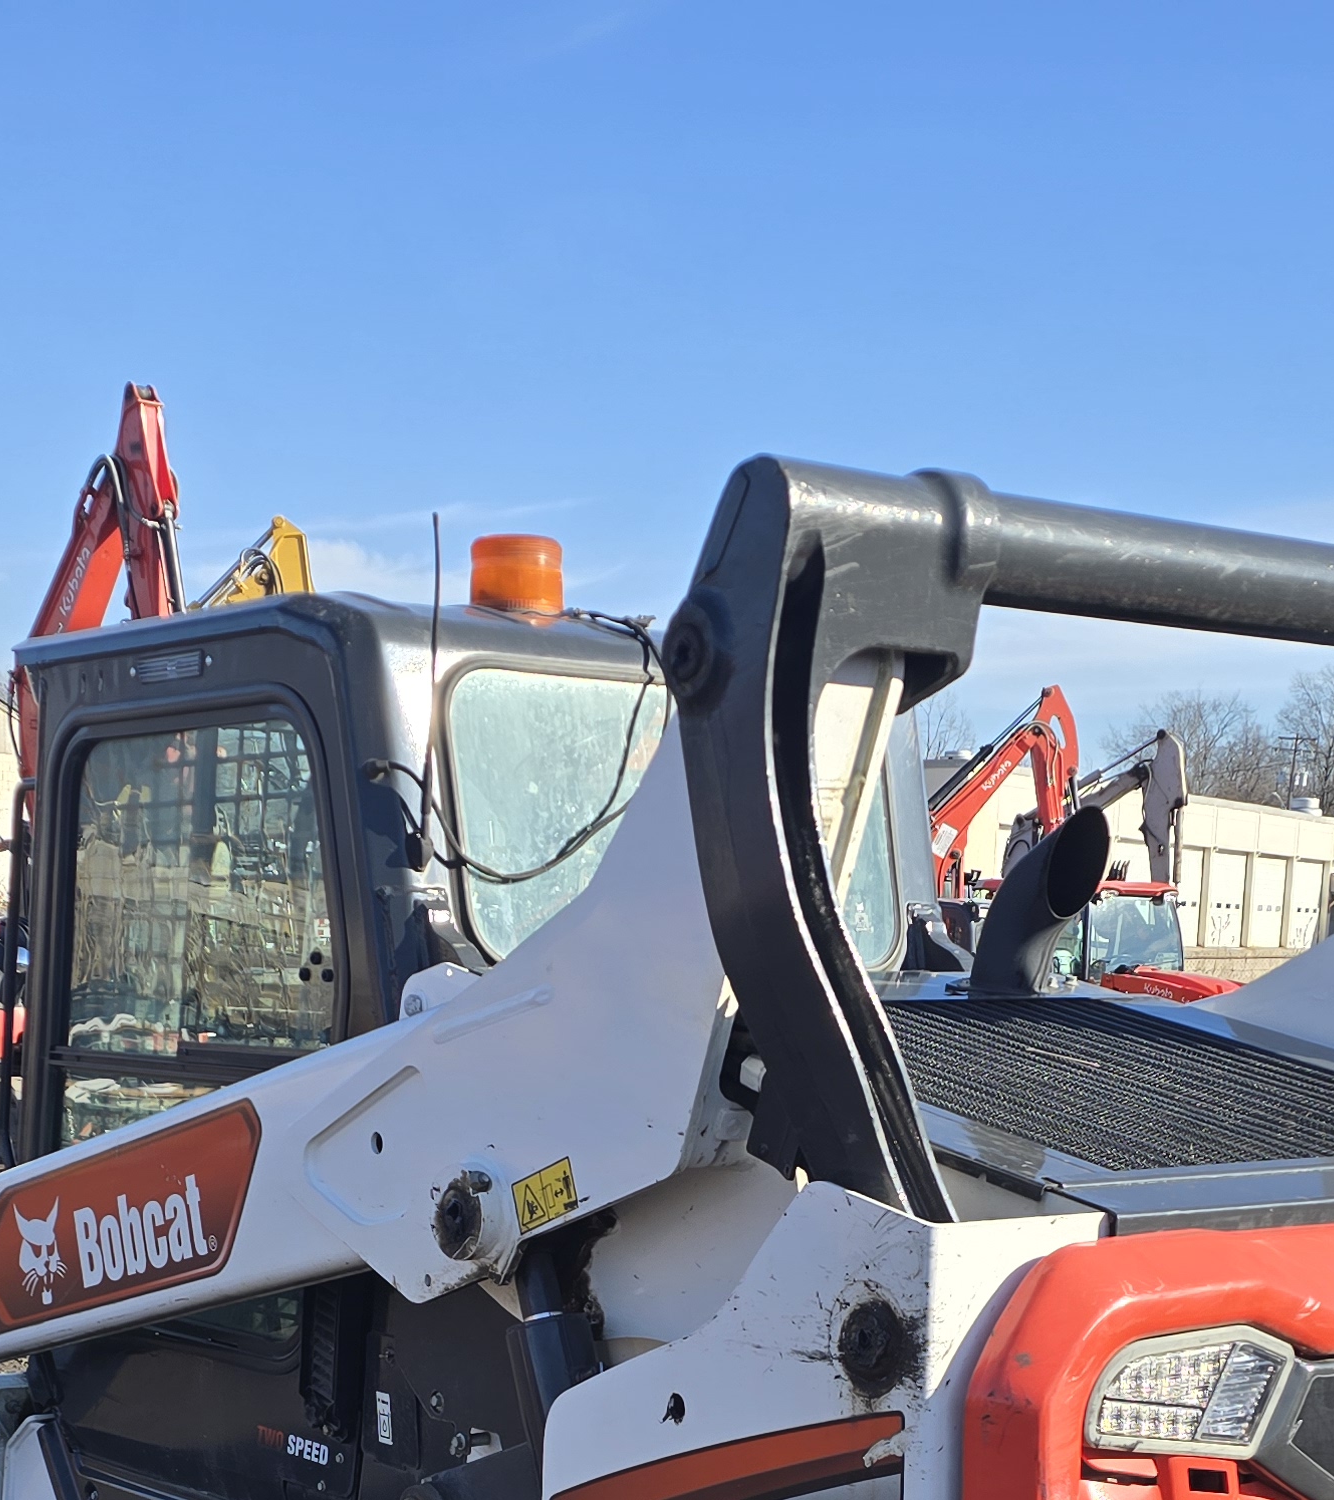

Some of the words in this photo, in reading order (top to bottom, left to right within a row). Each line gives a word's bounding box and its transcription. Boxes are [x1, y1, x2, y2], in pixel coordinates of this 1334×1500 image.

[59, 547, 91, 616] Kubota
[981, 760, 1012, 791] Kubota
[1144, 982, 1174, 999] Kubota
[73, 1174, 208, 1289] Bobcat
[257, 1424, 284, 1449] TWO
[286, 1434, 329, 1466] SPEED
